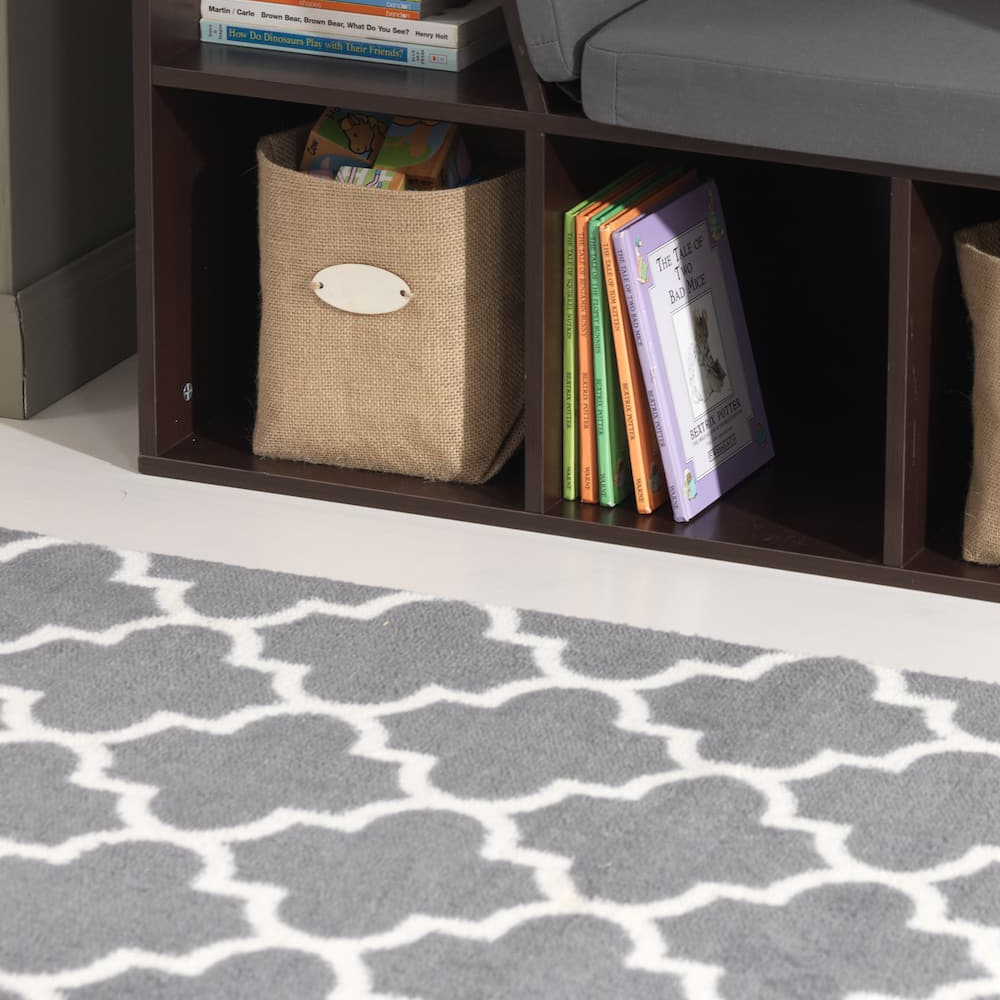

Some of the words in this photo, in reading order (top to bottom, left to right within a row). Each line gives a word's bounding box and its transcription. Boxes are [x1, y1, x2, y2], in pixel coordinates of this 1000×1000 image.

[208, 5, 231, 14] Martin
[236, 8, 255, 17] Carle
[261, 11, 283, 20] Brown
[284, 14, 303, 24] Bear,
[303, 16, 326, 26] Brown
[327, 19, 345, 28] Bear,
[346, 21, 365, 30] What
[378, 25, 391, 33] You
[392, 27, 410, 35] See?
[228, 28, 247, 38] How
[249, 31, 262, 40] Do
[263, 32, 304, 46] Dinosaurs
[305, 36, 322, 48] Play
[324, 38, 343, 51] with
[345, 40, 369, 53] Their
[415, 30, 434, 39] Henry
[600, 243, 609, 256] THE
[615, 248, 624, 262] THE
[655, 254, 673, 272] THE
[673, 242, 693, 261] TALE
[693, 235, 704, 250] OF
[603, 259, 612, 275] TALE
[619, 265, 629, 281] TALE
[674, 262, 693, 280] TWO
[623, 283, 632, 293] OF
[668, 287, 686, 305] BAD
[686, 272, 705, 294] MICE
[608, 289, 617, 304] TOM
[626, 295, 636, 312] TWO
[630, 312, 640, 328] BAD
[689, 412, 716, 441] BEATRIX
[716, 397, 743, 422] POTTER
